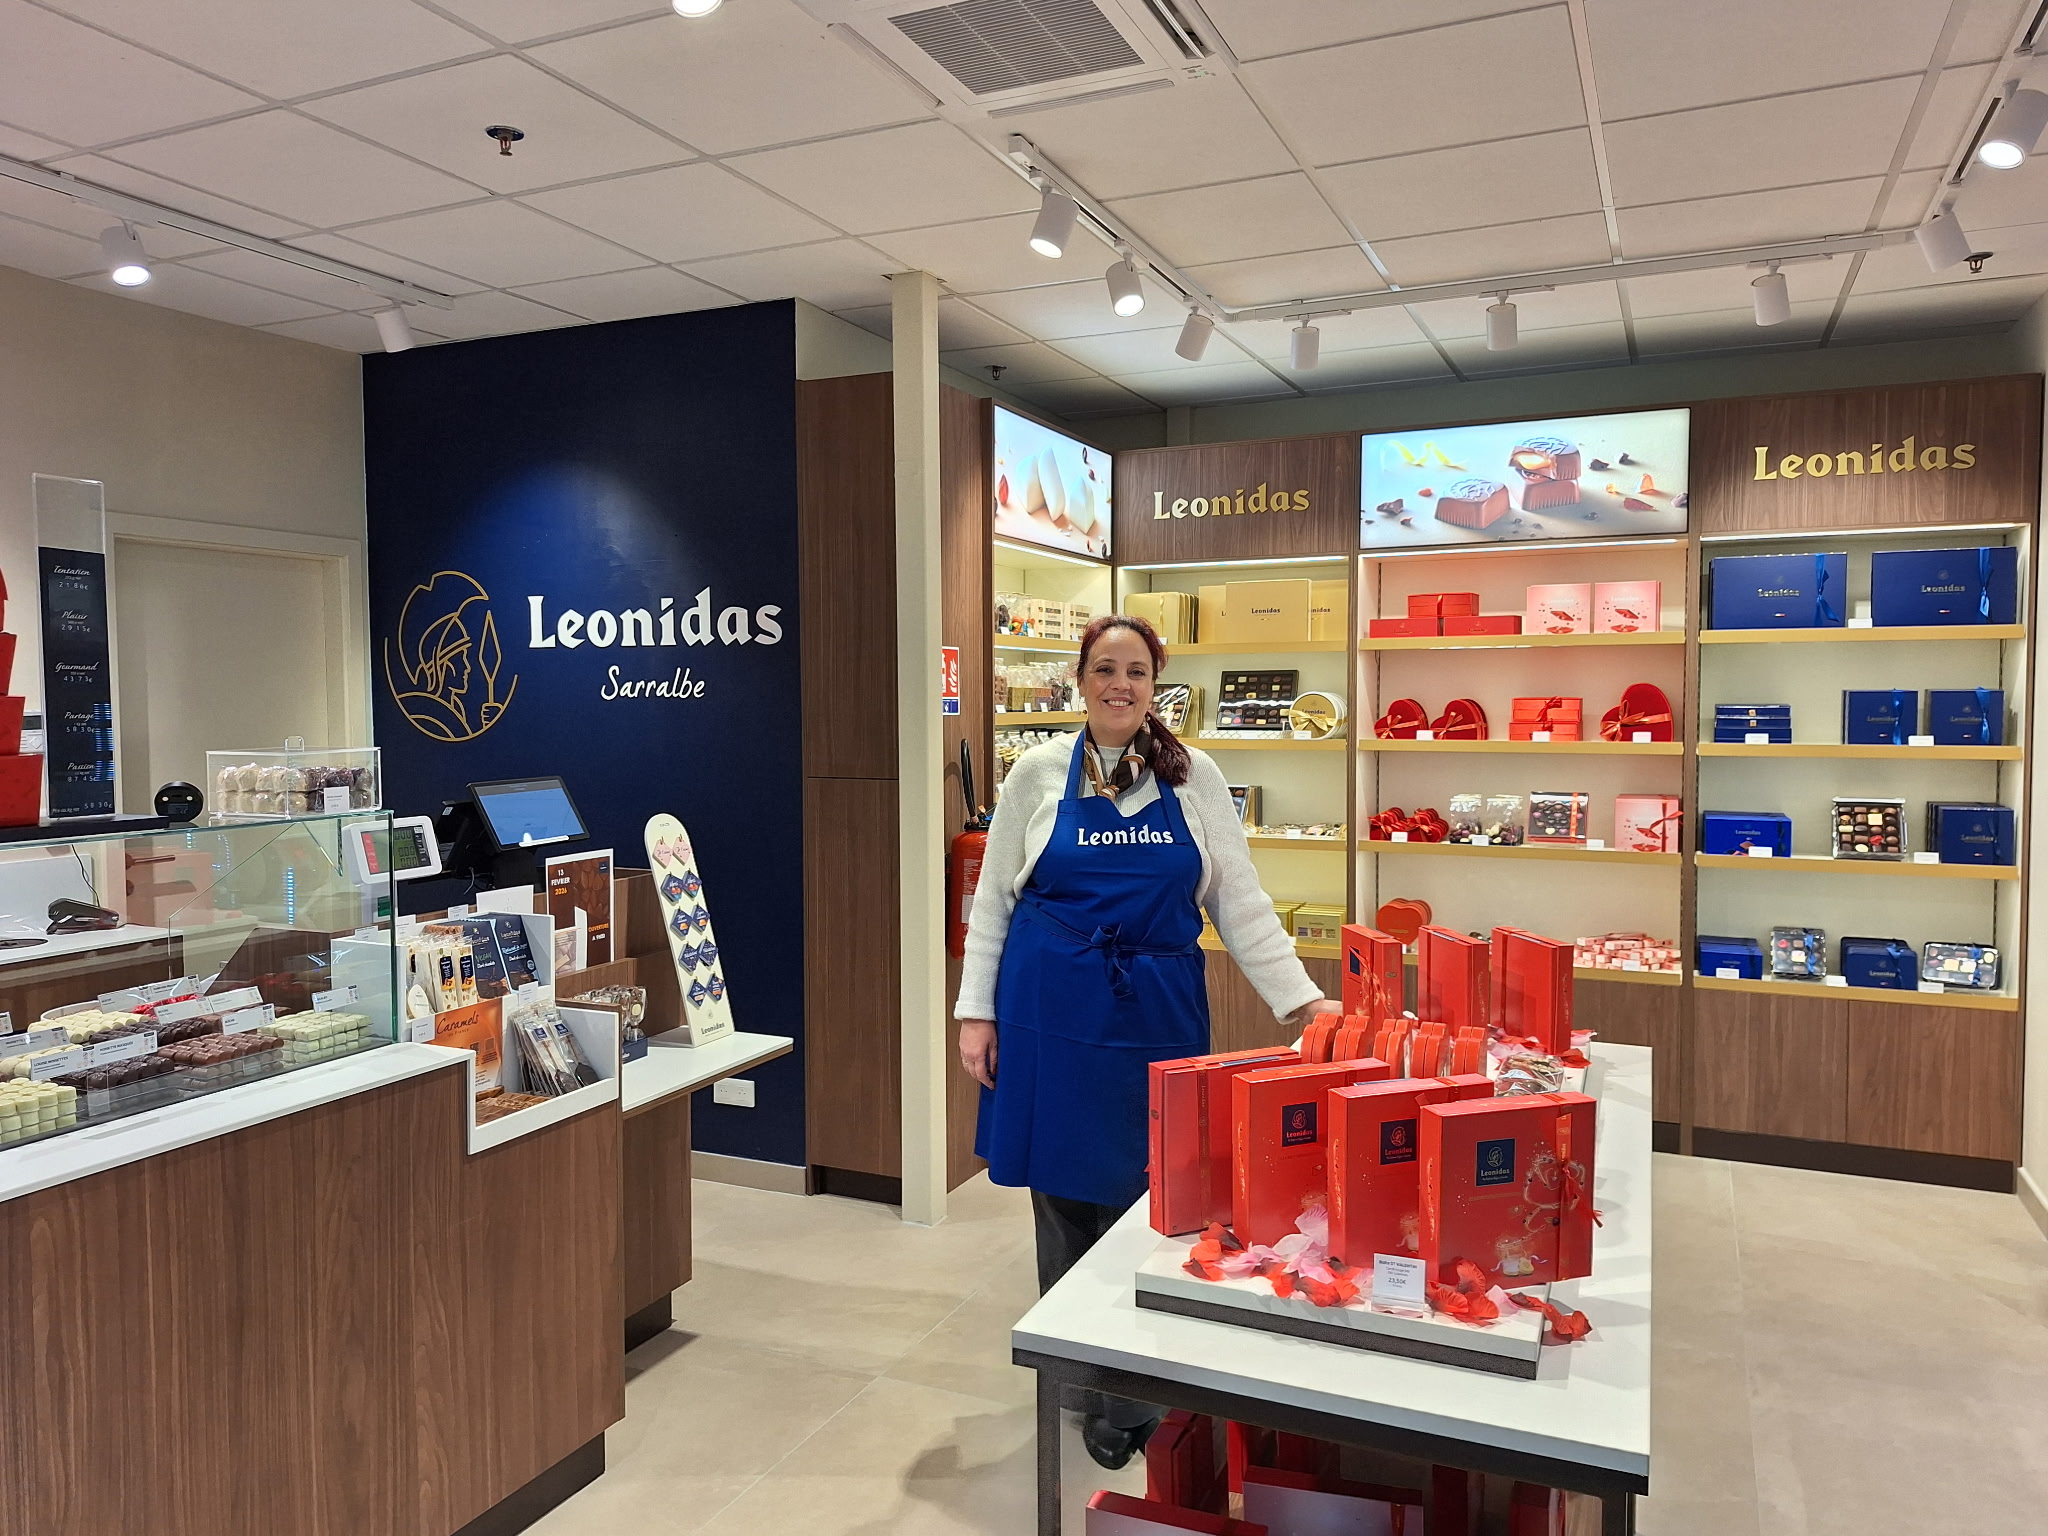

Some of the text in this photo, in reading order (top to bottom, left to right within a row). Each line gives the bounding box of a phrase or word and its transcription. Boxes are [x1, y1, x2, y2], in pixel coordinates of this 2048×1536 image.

[1754, 435, 1977, 481] Leonidas
[1152, 482, 1311, 520] Leonidas
[527, 585, 783, 649] Leonidas
[55, 661, 100, 673] Gourmand
[600, 665, 706, 701] Sarralbe
[64, 711, 95, 722] Partage
[1077, 824, 1174, 846] Leonidas
[436, 1011, 480, 1035] Caramels
[701, 1022, 726, 1035] Leonidas
[1286, 1129, 1313, 1139] Leonidas
[1384, 1146, 1413, 1156] Leonidas
[1481, 1168, 1510, 1177] Leonidas
